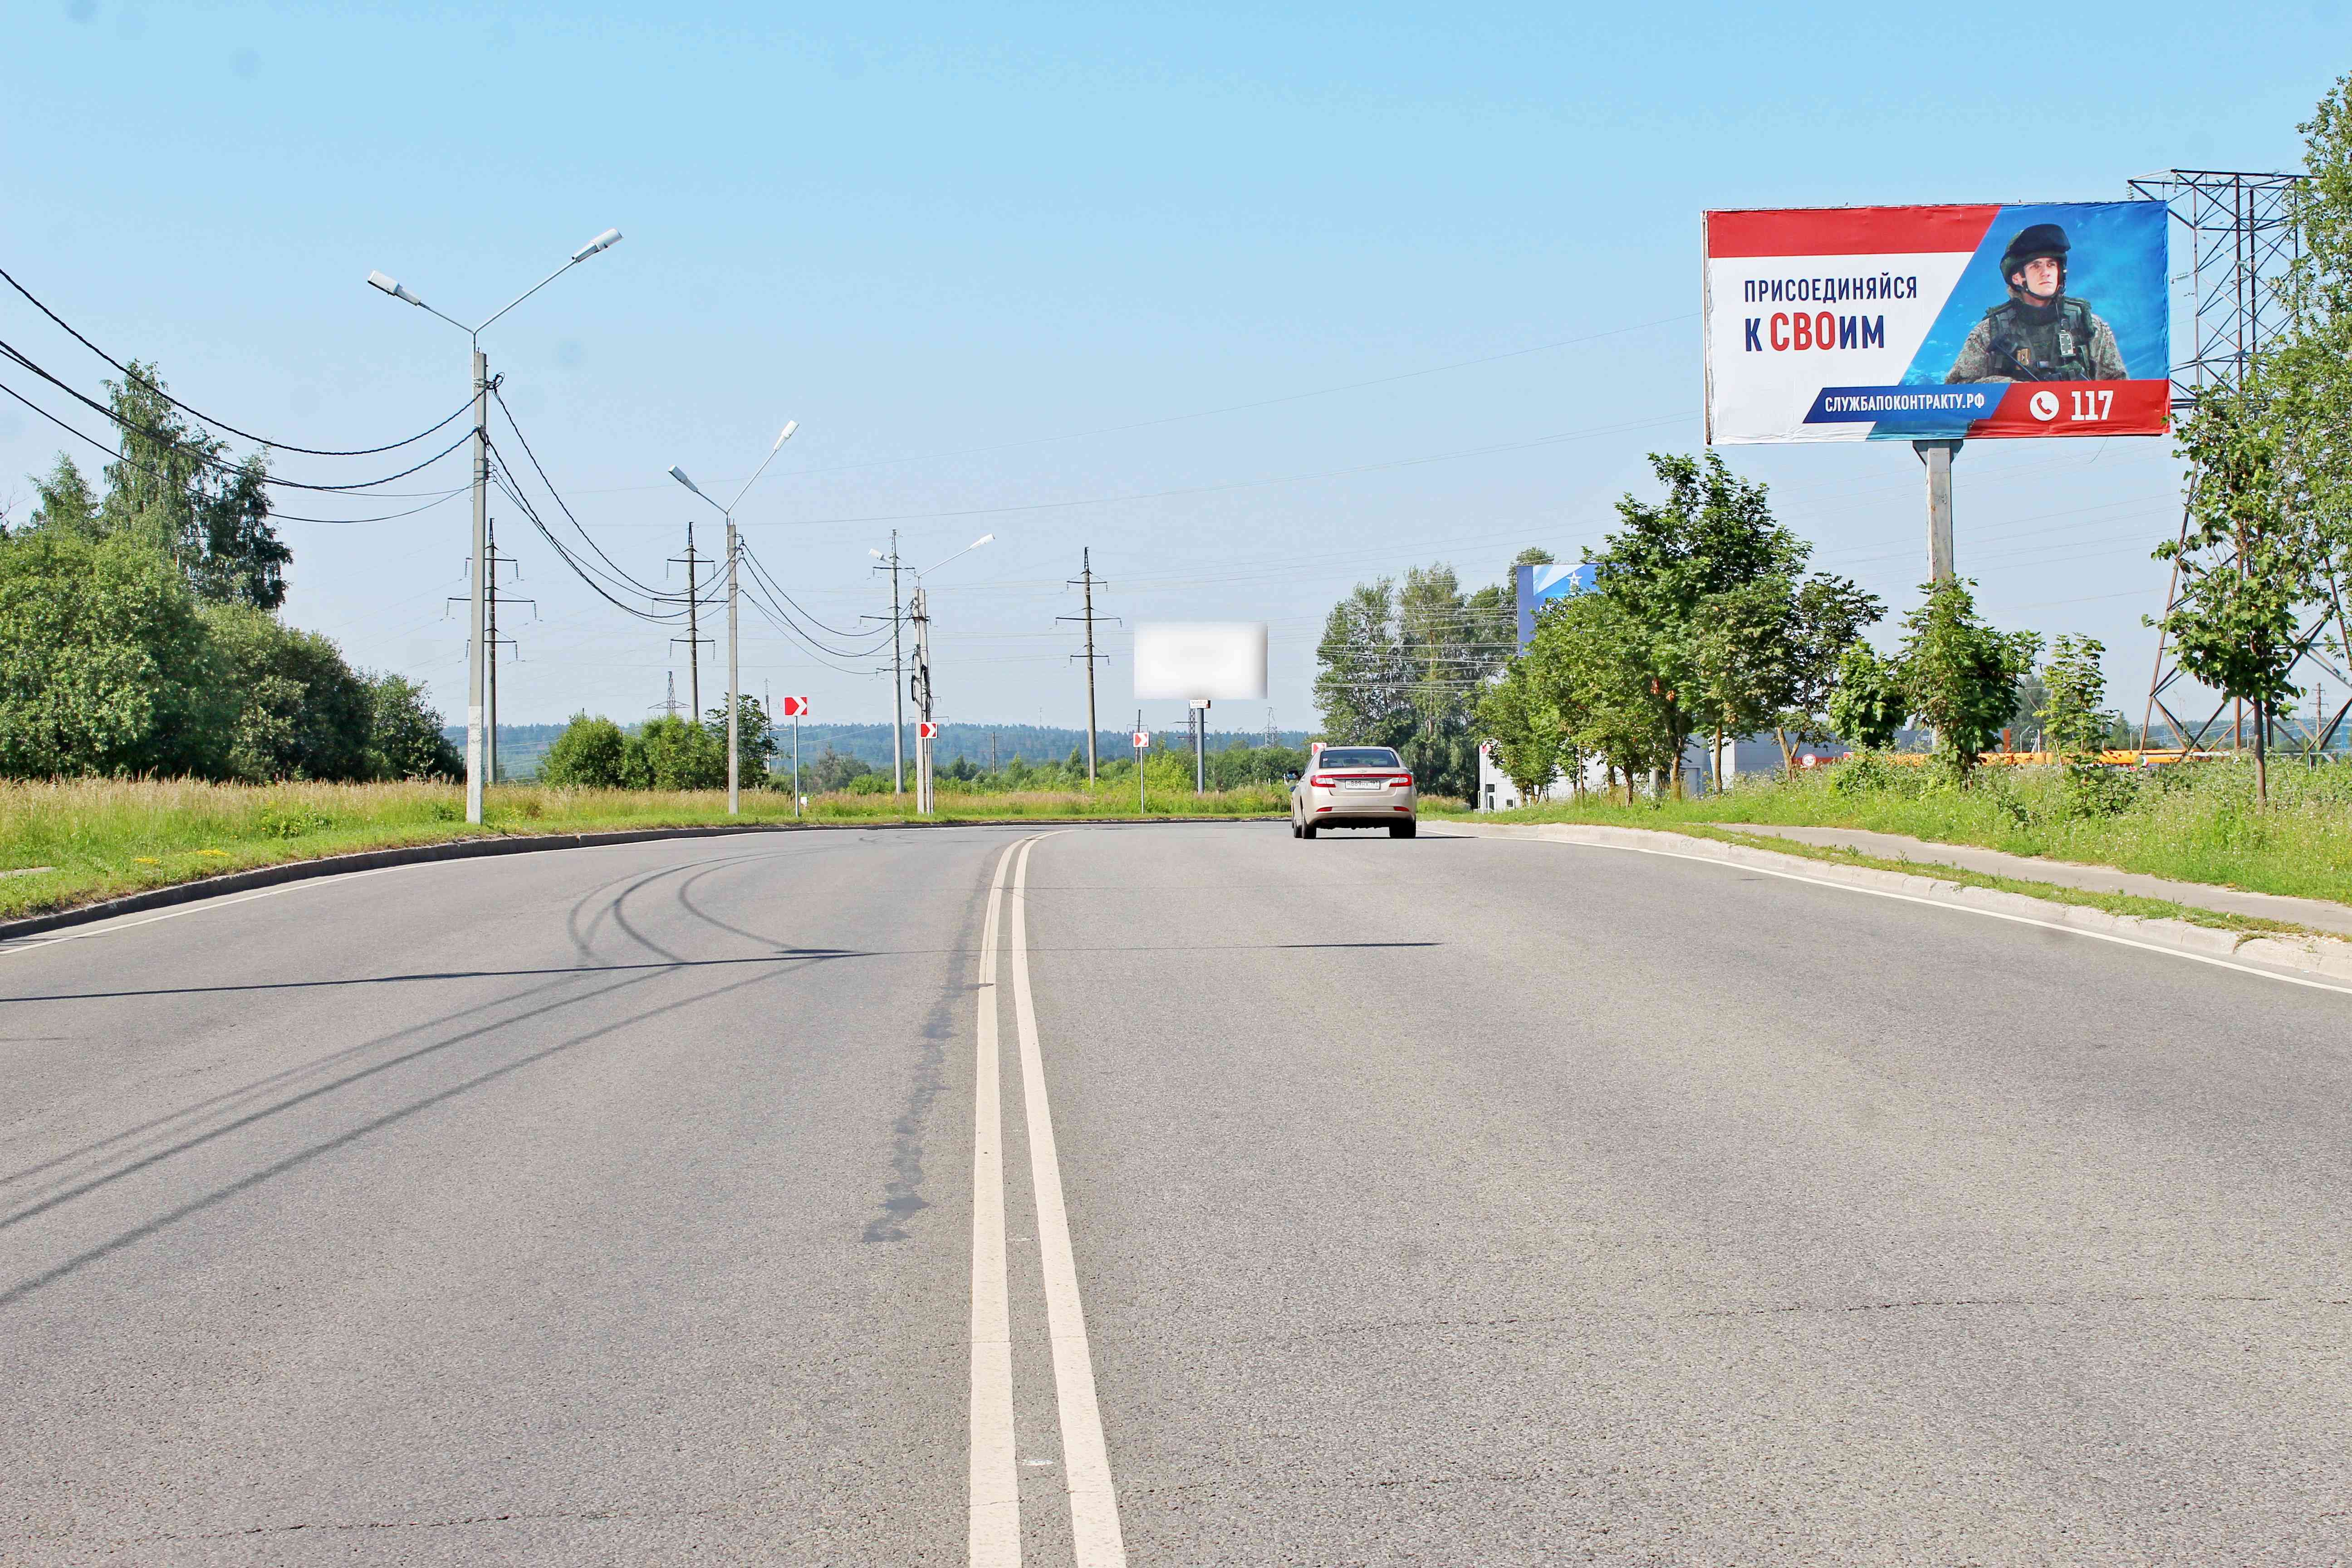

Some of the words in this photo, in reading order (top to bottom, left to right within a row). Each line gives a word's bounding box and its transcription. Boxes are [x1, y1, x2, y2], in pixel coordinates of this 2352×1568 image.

[1744, 272, 1916, 304] ПРИСОЕДИНЯЙСЯ
[1745, 318, 1763, 352] К
[1825, 393, 1984, 412] СЛУЖБАПОКОНТРАКТУ.РФ
[2071, 390, 2113, 421] 117
